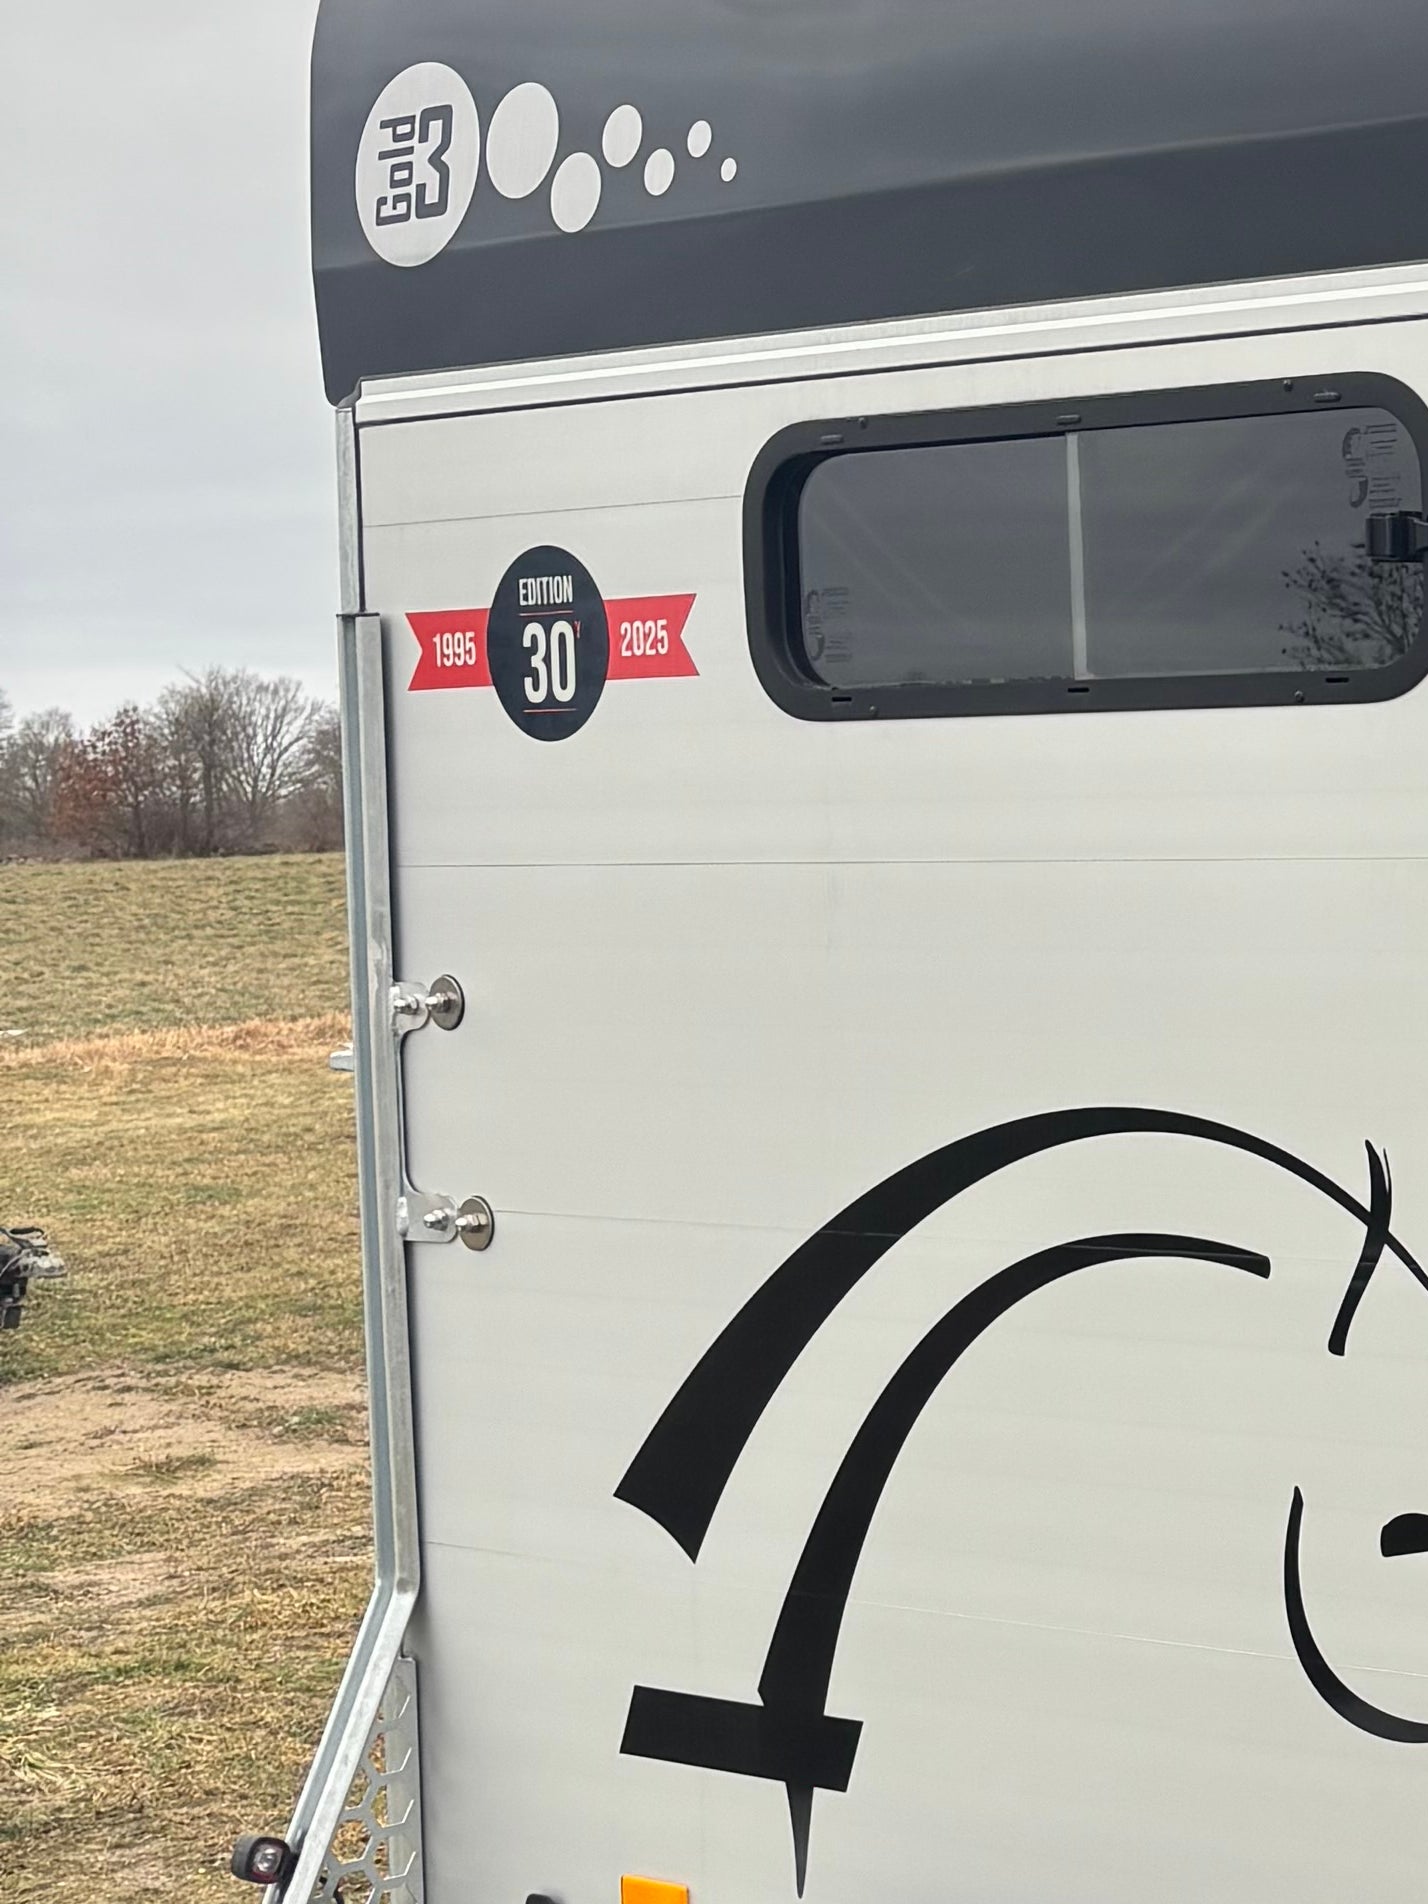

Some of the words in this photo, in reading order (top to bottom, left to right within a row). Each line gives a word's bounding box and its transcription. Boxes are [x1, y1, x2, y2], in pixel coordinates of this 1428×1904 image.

[414, 104, 454, 220] 3
[518, 575, 573, 606] EDITION
[432, 632, 476, 668] 1995
[620, 619, 668, 657] 2025
